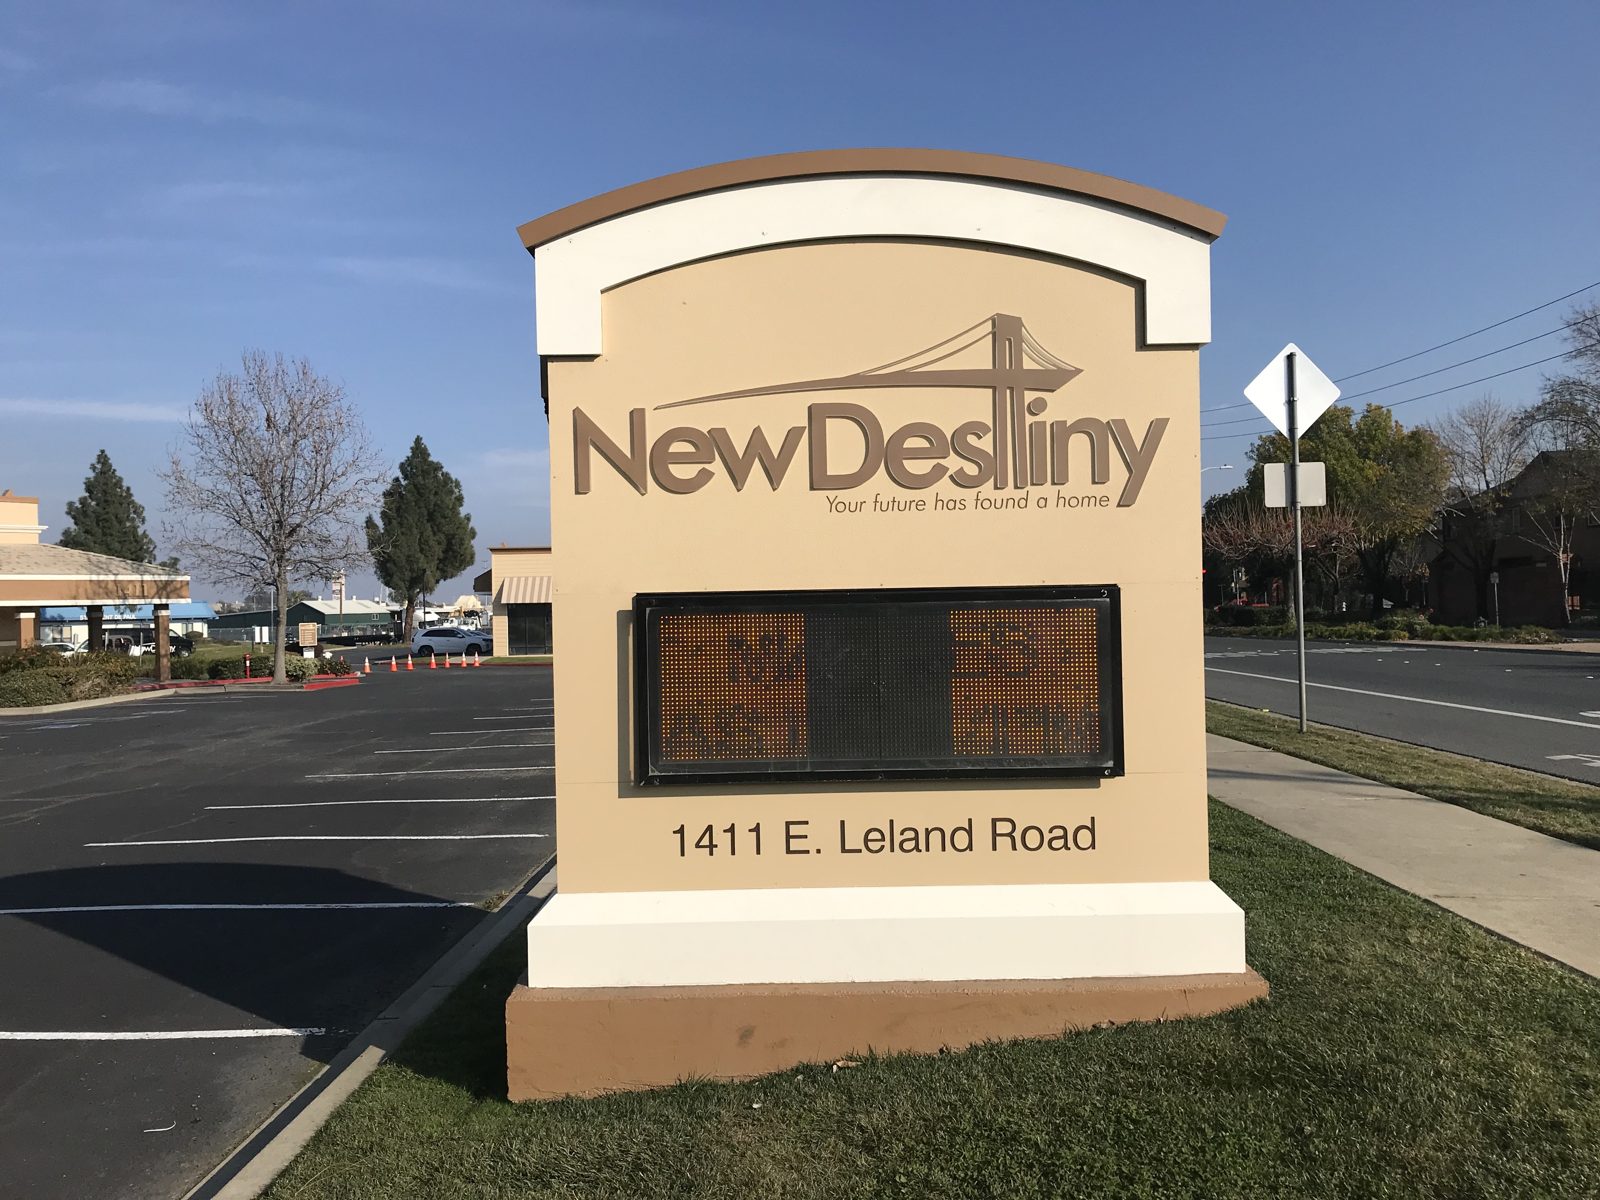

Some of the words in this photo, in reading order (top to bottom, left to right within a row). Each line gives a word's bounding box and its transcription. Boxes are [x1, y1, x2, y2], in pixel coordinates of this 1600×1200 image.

[826, 495, 867, 513] Your
[873, 493, 926, 512] future
[934, 492, 967, 511] has
[974, 490, 1030, 510] found
[1036, 496, 1048, 508] a
[1056, 489, 1110, 508] home
[672, 822, 761, 857] 1411
[784, 820, 822, 855] E.
[839, 817, 974, 854] Leland
[990, 816, 1096, 852] Road
